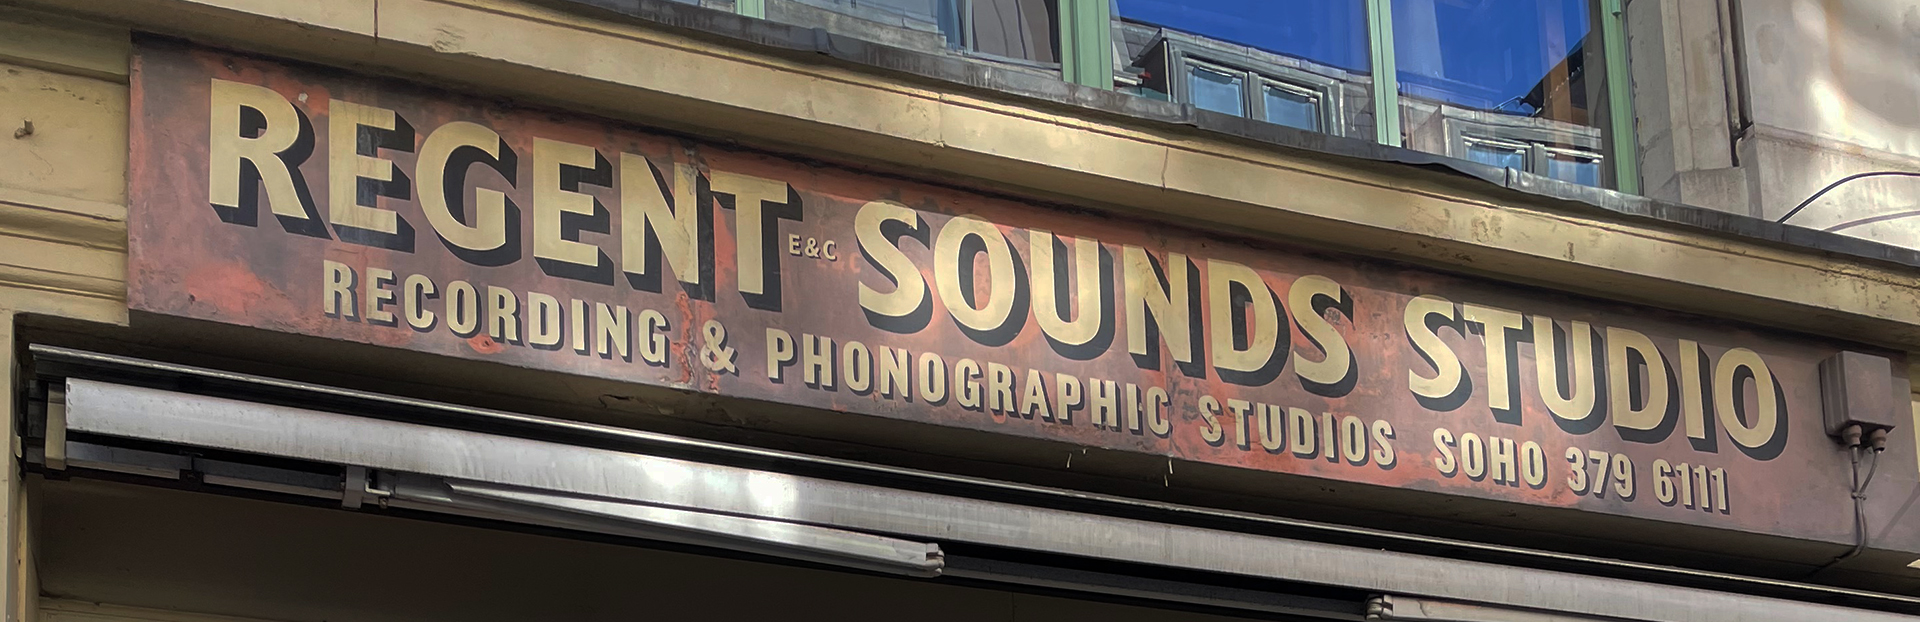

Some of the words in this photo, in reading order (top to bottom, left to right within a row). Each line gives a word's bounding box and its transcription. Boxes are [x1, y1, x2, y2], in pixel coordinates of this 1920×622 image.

[209, 78, 802, 311] REGENT
[854, 201, 1358, 398] SOUNDS
[1404, 295, 1788, 460] STUDIO
[788, 233, 838, 262] E&C
[323, 260, 671, 367] RECORDING
[700, 319, 739, 377] &
[766, 328, 1173, 438] PHONOGRAPHIC
[1199, 395, 1397, 469] STUDIOS
[1434, 428, 1548, 489] SOHO
[1565, 449, 1636, 501] 379
[1653, 459, 1730, 515] 6111
